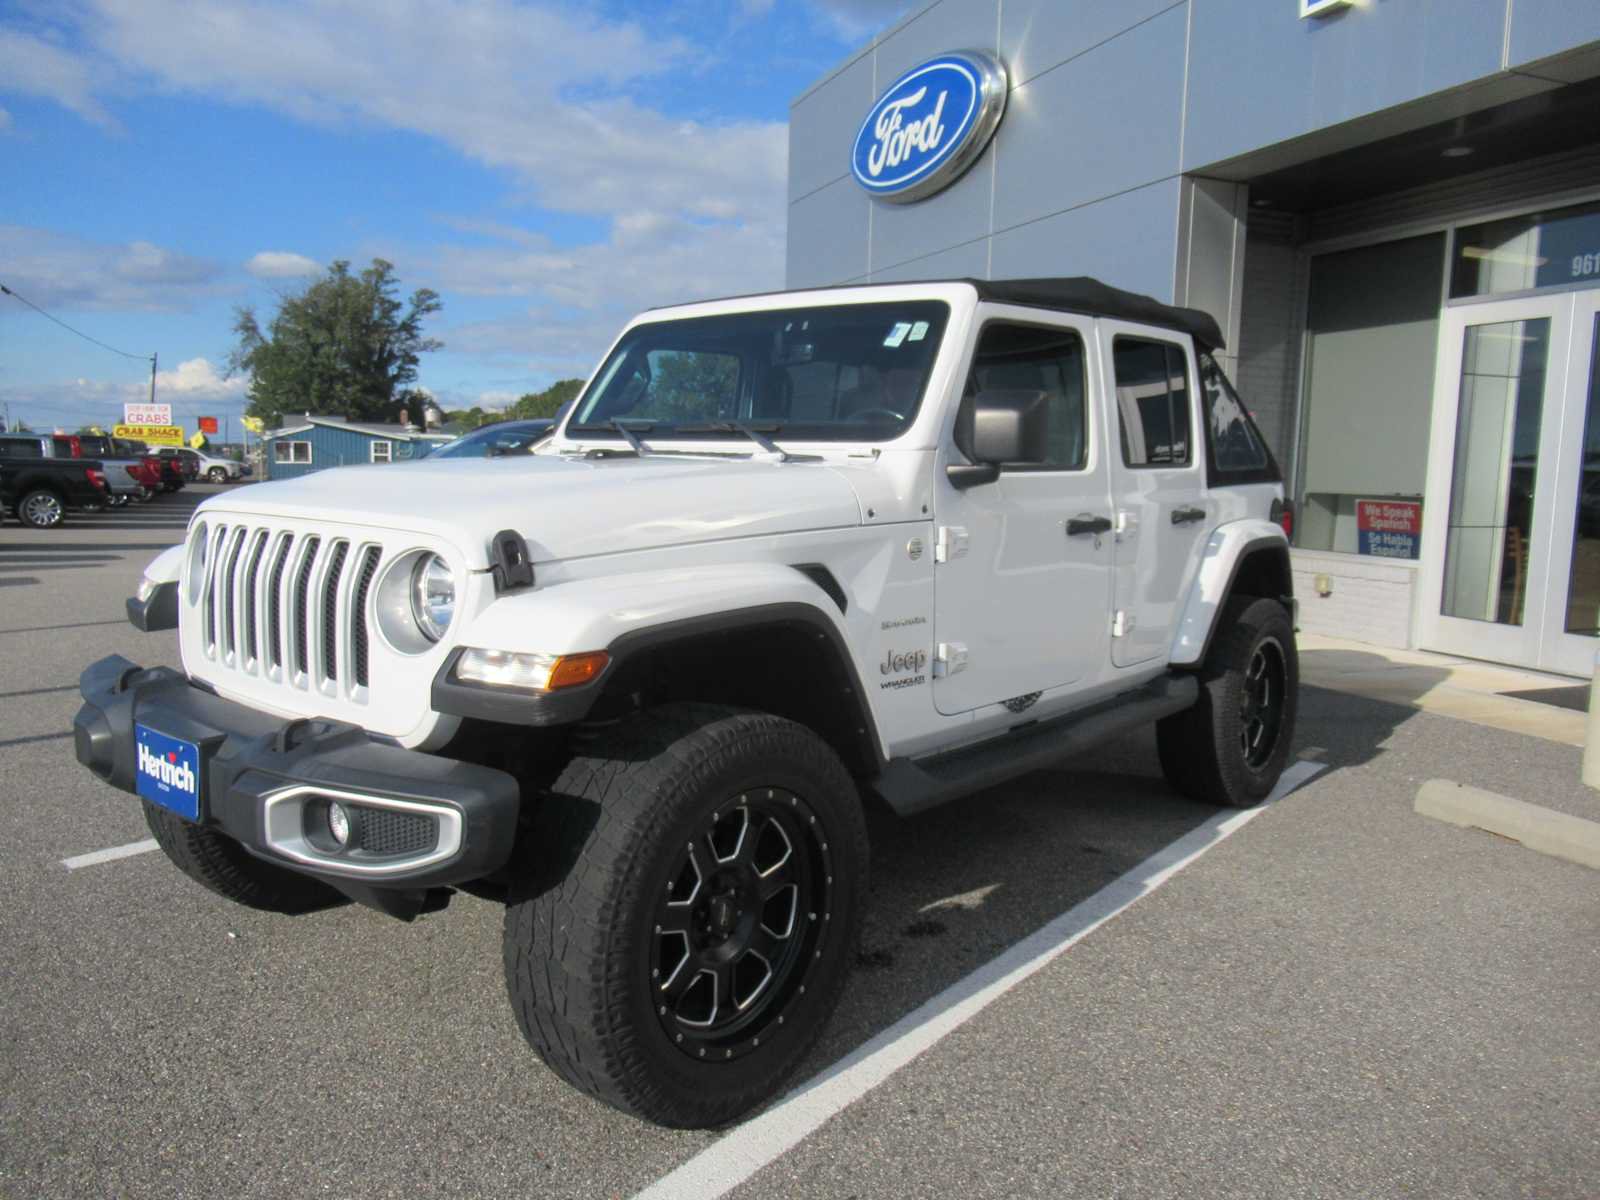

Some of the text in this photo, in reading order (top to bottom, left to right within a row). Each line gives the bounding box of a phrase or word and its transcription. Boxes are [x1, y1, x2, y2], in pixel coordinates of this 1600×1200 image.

[869, 86, 947, 176] Ford
[128, 413, 168, 424] CRABS
[116, 427, 144, 437] CRAB
[1383, 505, 1415, 519] Speak
[1370, 517, 1410, 531] Spanish
[881, 649, 926, 675] Jeep
[138, 742, 195, 794] Hertrich
